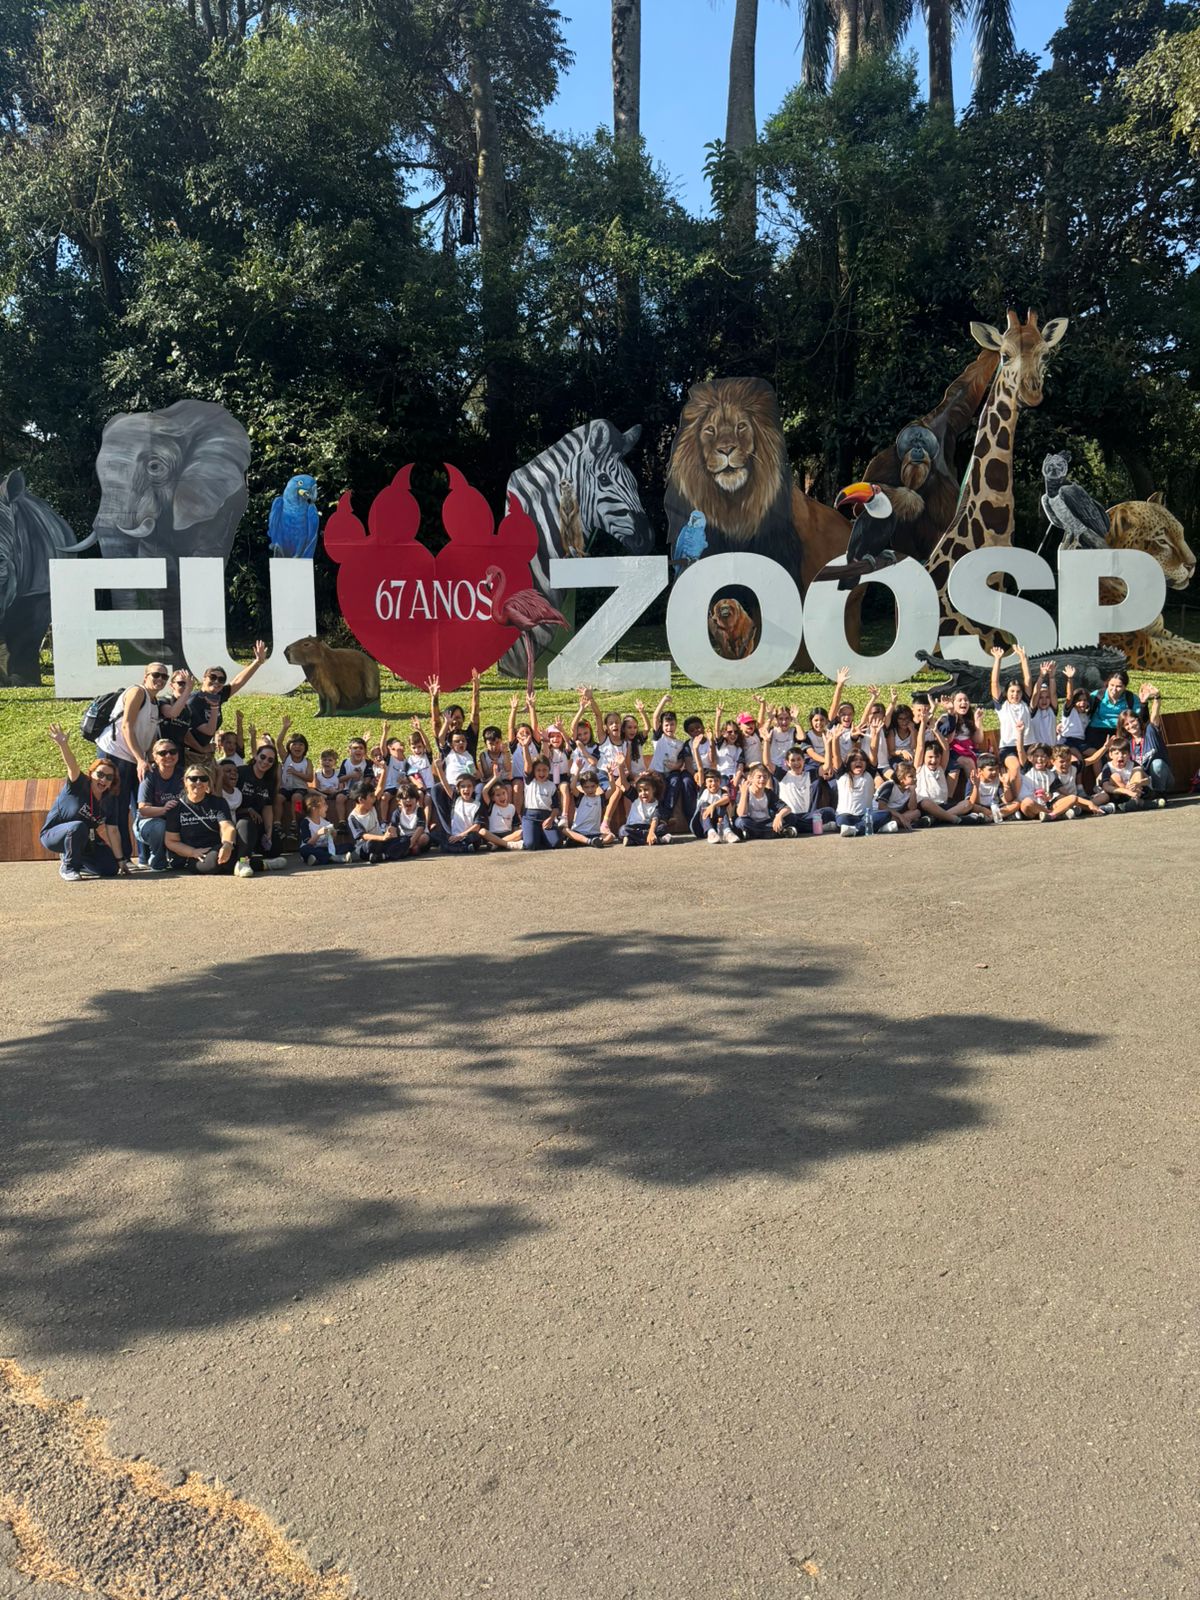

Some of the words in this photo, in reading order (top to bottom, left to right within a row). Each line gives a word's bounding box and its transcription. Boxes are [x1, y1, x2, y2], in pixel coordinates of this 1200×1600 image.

[49, 557, 318, 698] EU
[547, 547, 1167, 691] ZOOSP
[375, 578, 407, 621] 67
[408, 579, 494, 621] ANOS
